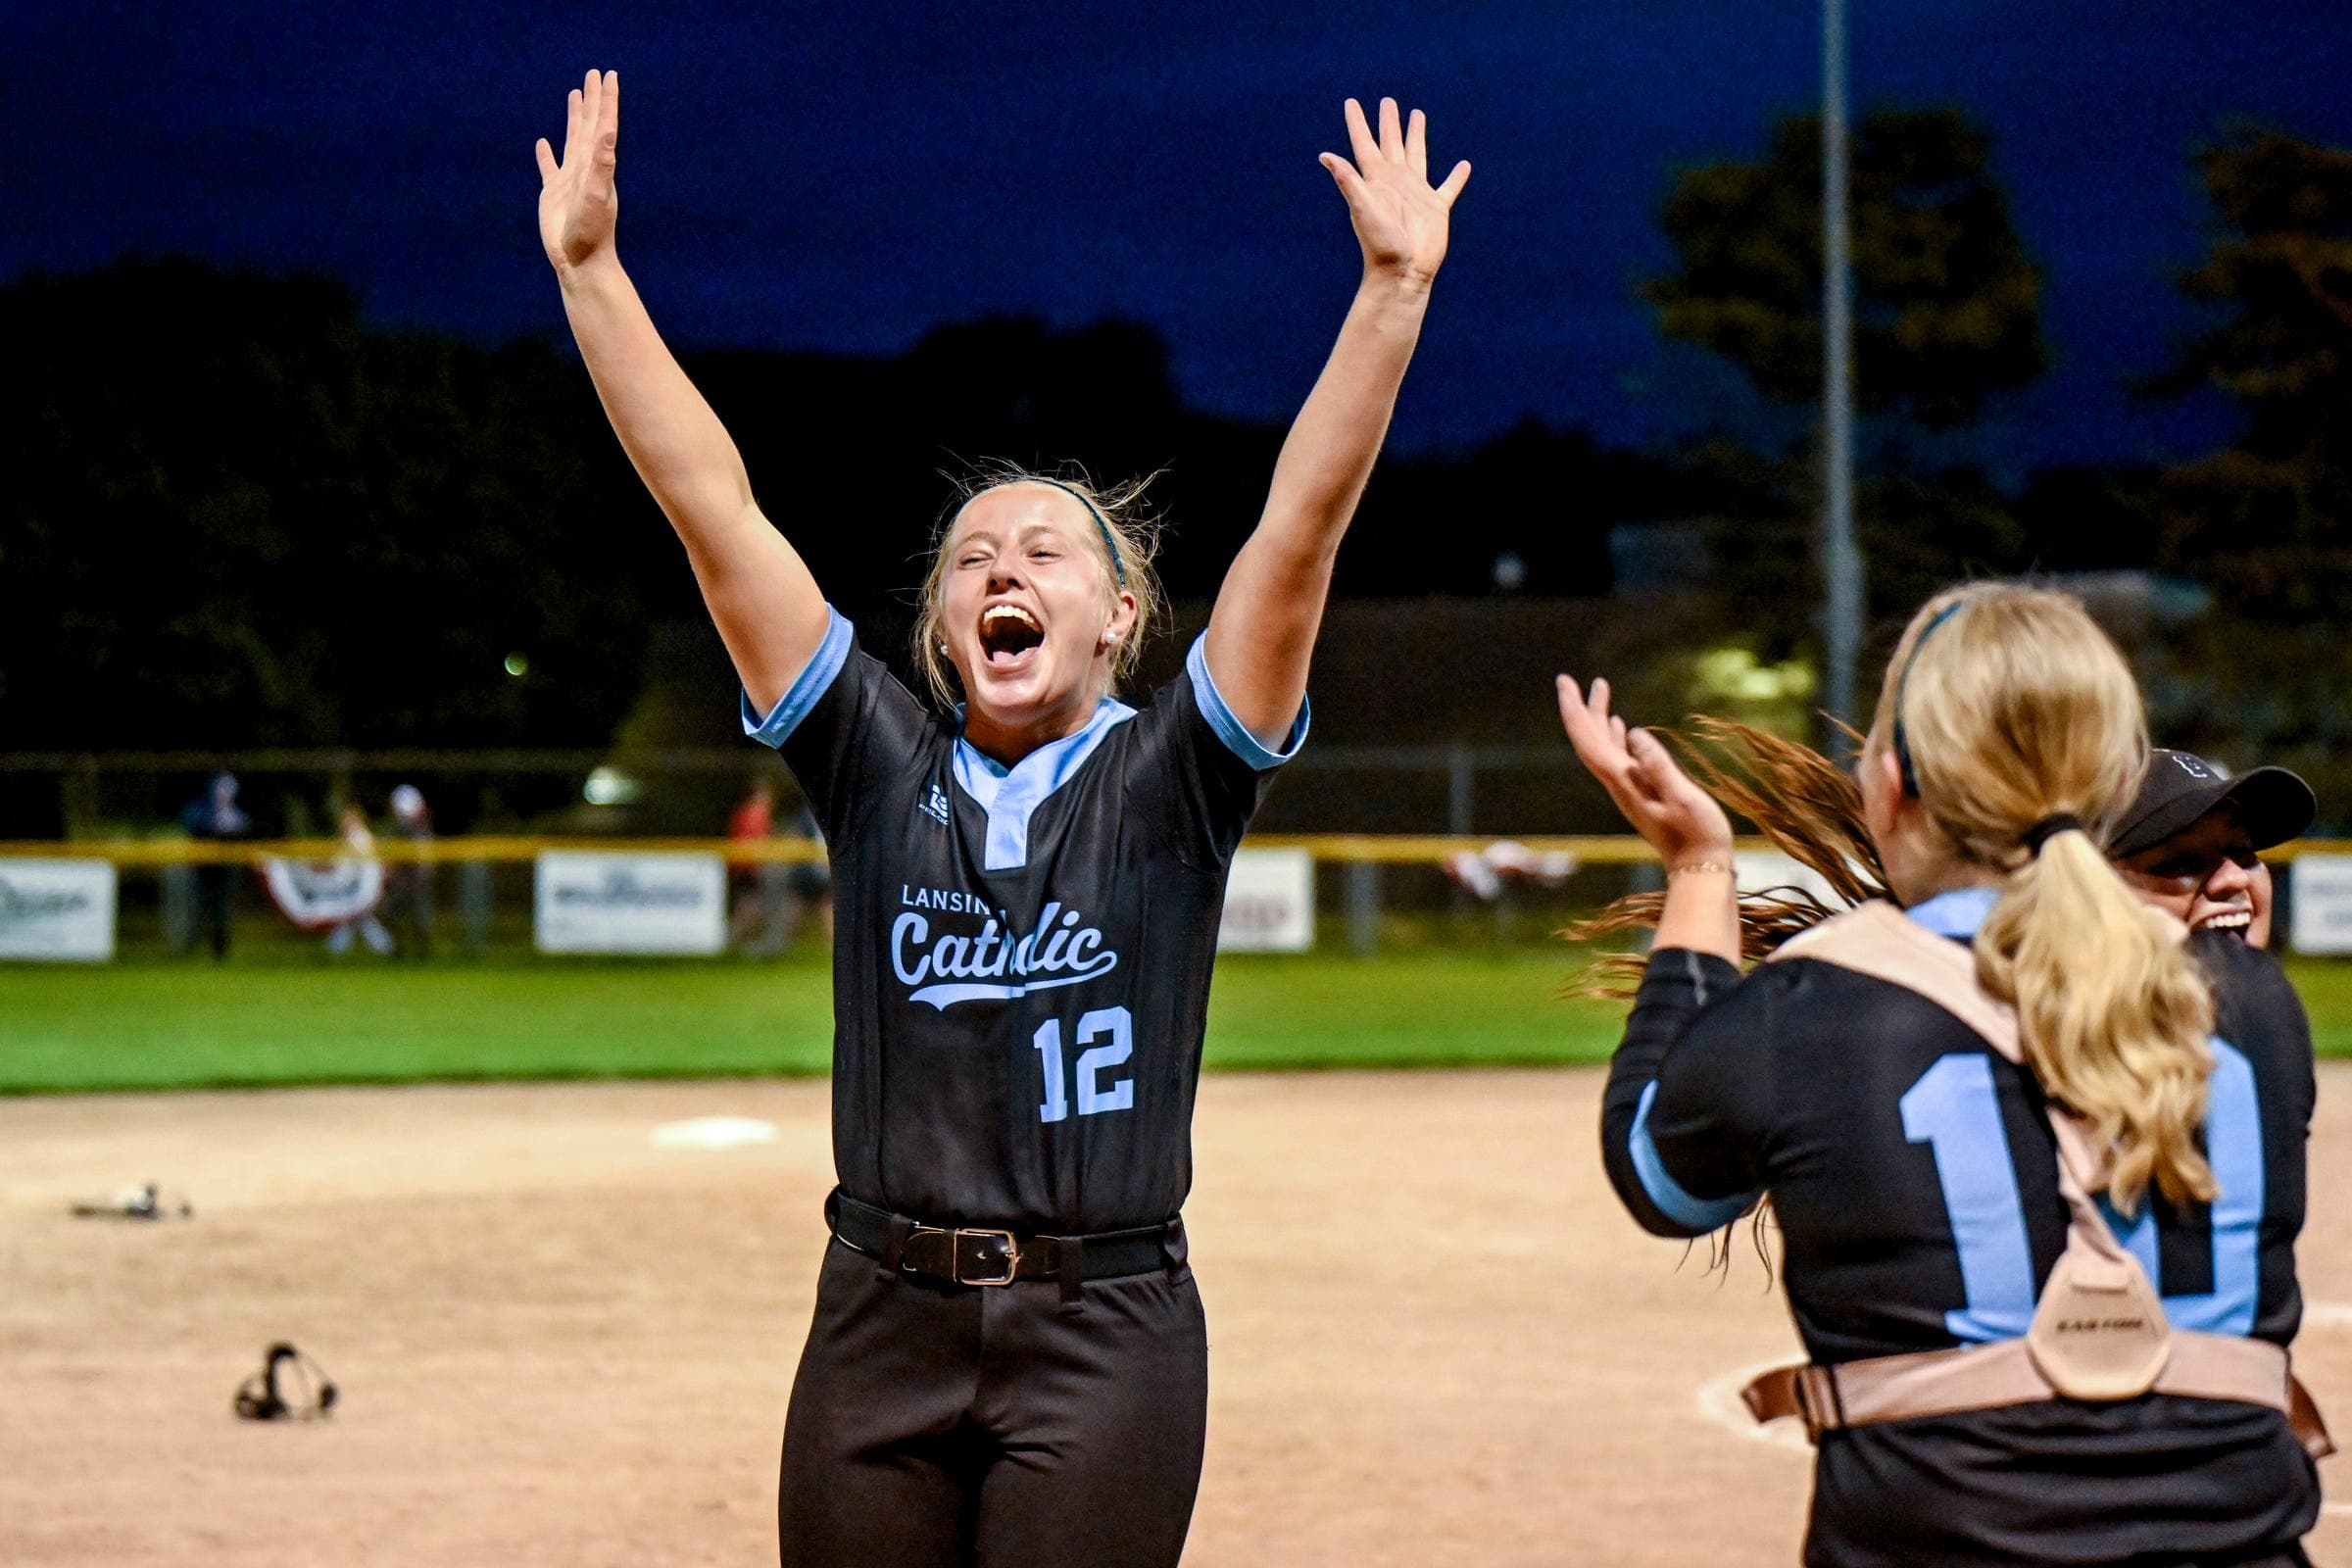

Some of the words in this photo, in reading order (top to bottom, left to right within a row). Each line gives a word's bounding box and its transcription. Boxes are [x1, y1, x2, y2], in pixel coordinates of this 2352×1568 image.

[902, 884, 992, 915] LANSIN
[1033, 1005, 1133, 1122] 12
[1899, 1037, 2264, 1348] 10
